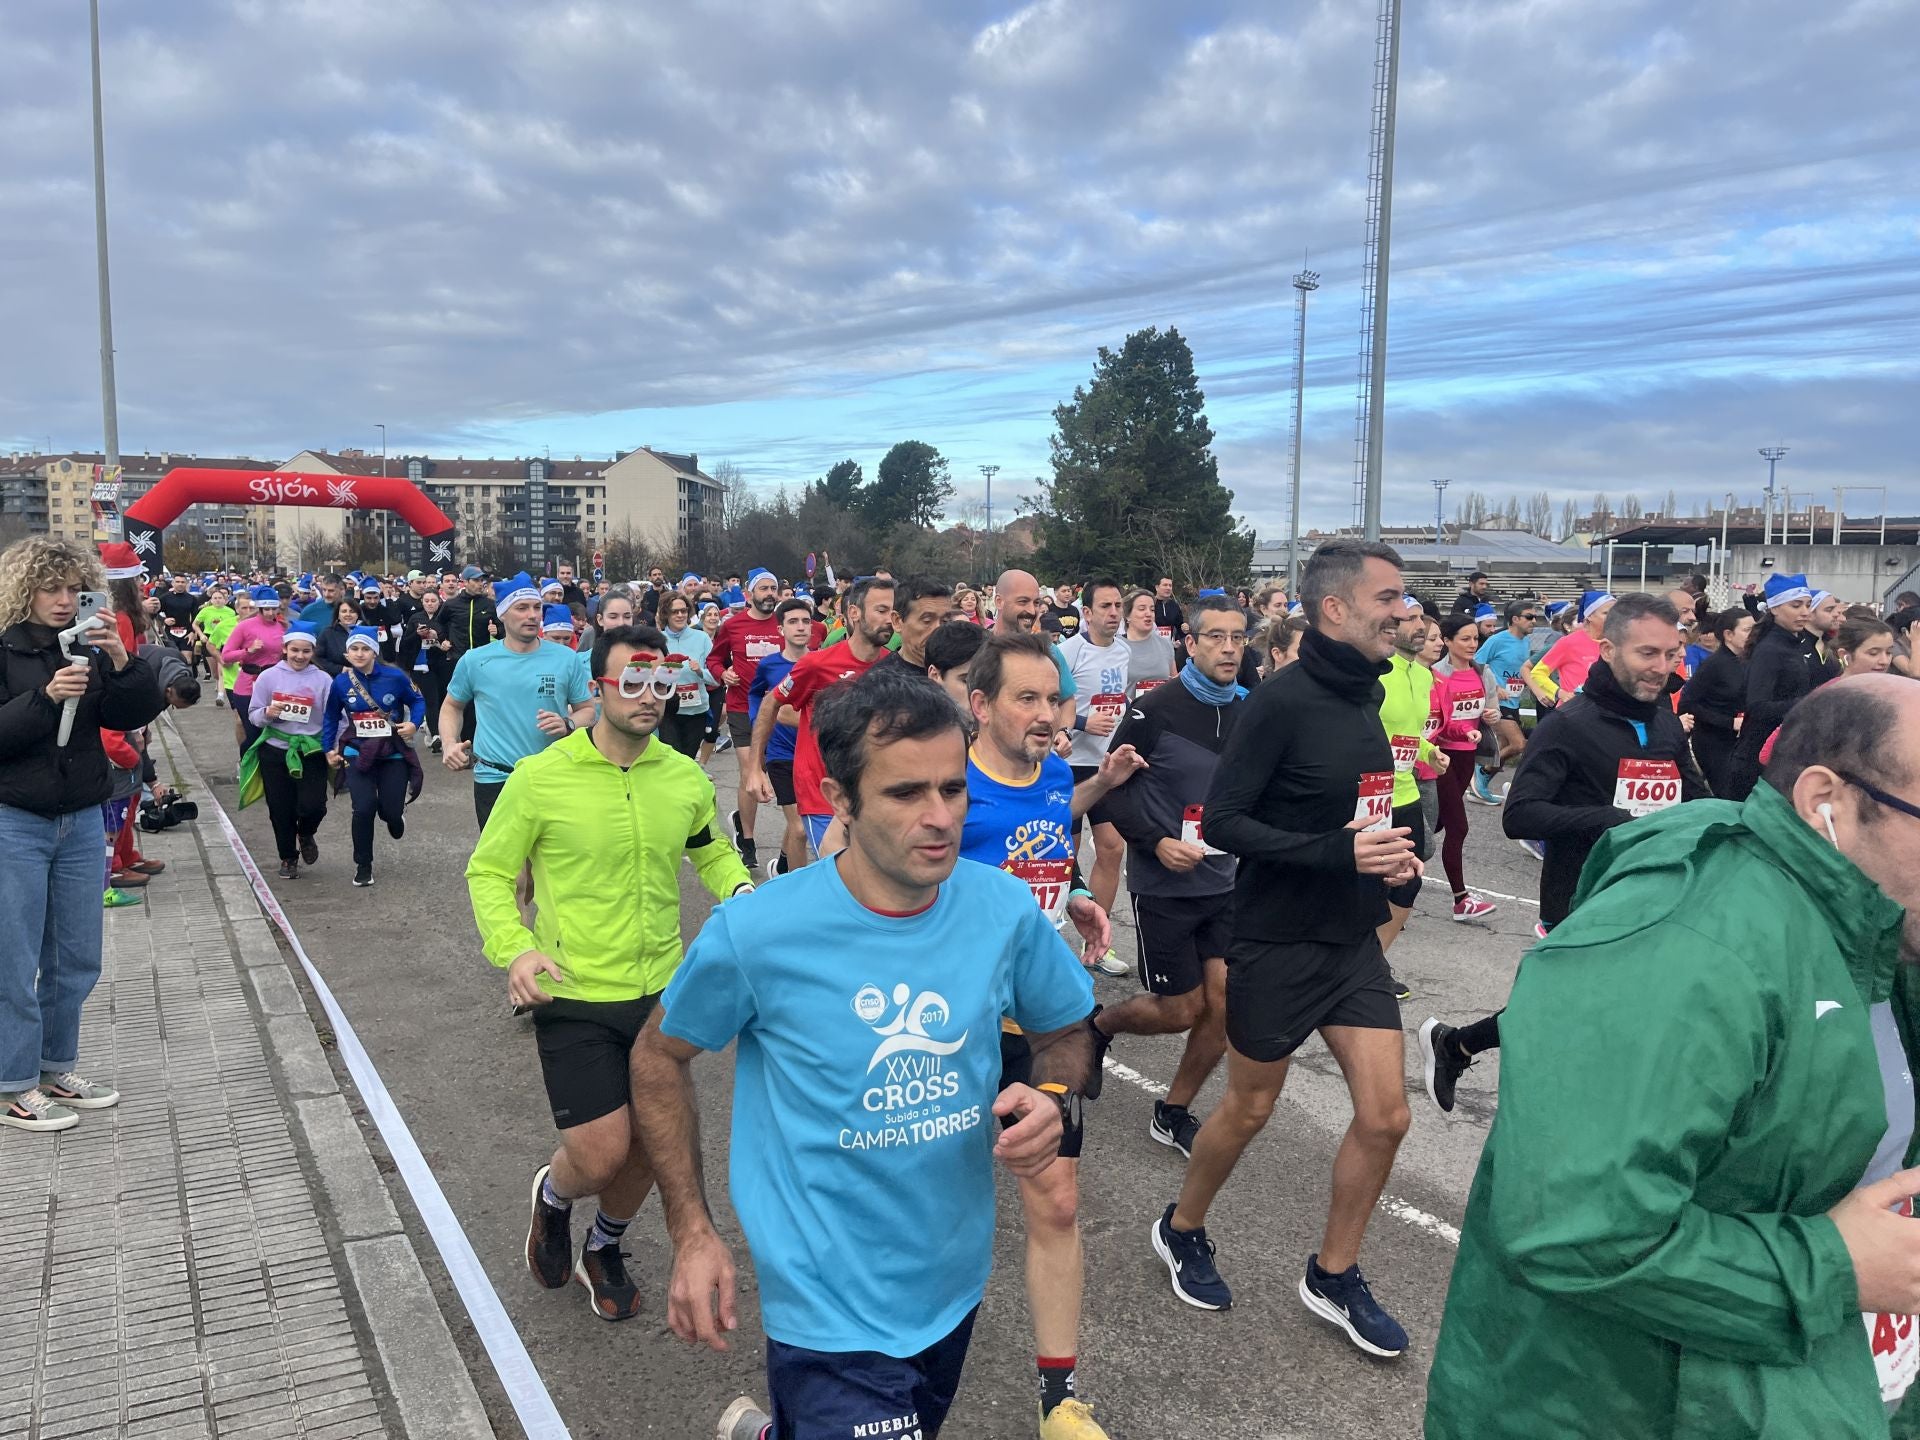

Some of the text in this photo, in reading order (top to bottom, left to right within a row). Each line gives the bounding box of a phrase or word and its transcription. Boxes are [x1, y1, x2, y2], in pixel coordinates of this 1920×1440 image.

[91, 491, 116, 500] NAVIDAD
[1101, 667, 1122, 684] SM
[680, 692, 694, 701] 56
[1456, 700, 1480, 711] 404
[360, 720, 386, 730] 4318
[1423, 720, 1438, 731] 98
[1626, 781, 1677, 801] 1600
[921, 1010, 943, 1024] 2017
[885, 1055, 941, 1084] XXVIII
[863, 1071, 959, 1112] CROSS
[885, 1104, 941, 1125] Subida a la
